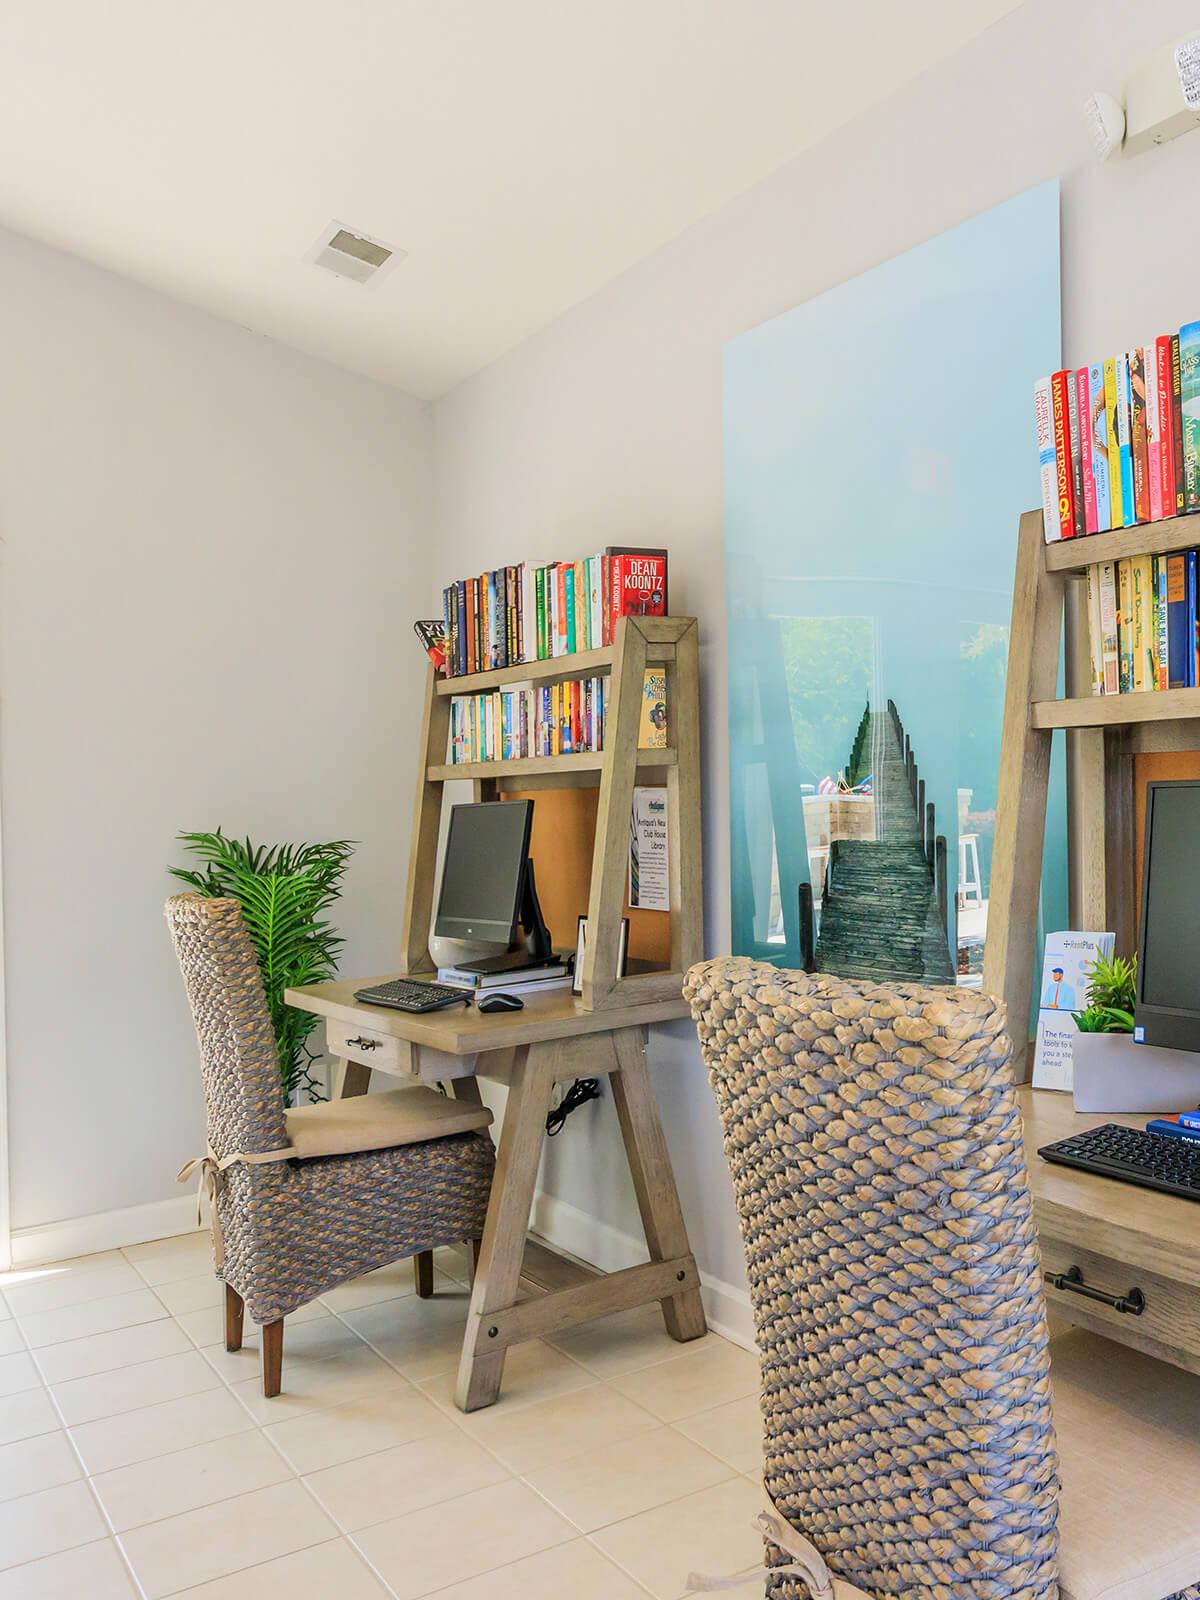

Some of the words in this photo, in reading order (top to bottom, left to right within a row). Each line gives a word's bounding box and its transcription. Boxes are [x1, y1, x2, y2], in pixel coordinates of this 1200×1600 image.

[1158, 345, 1166, 376] Winter
[1052, 378, 1061, 420] JAMES
[1067, 377, 1076, 420] BRISTOL
[1079, 374, 1087, 409] KIMBERLA
[1159, 379, 1165, 389] in
[1158, 391, 1167, 432] Paradise
[1071, 425, 1079, 457] PALIN
[1055, 421, 1067, 496] PATTERSON
[624, 575, 663, 590] KOONTZ
[631, 561, 657, 575] DEAN
[1159, 628, 1166, 637] ME
[1044, 1040, 1059, 1048] tools
[1061, 1040, 1068, 1048] to
[1046, 1031, 1057, 1039] The
